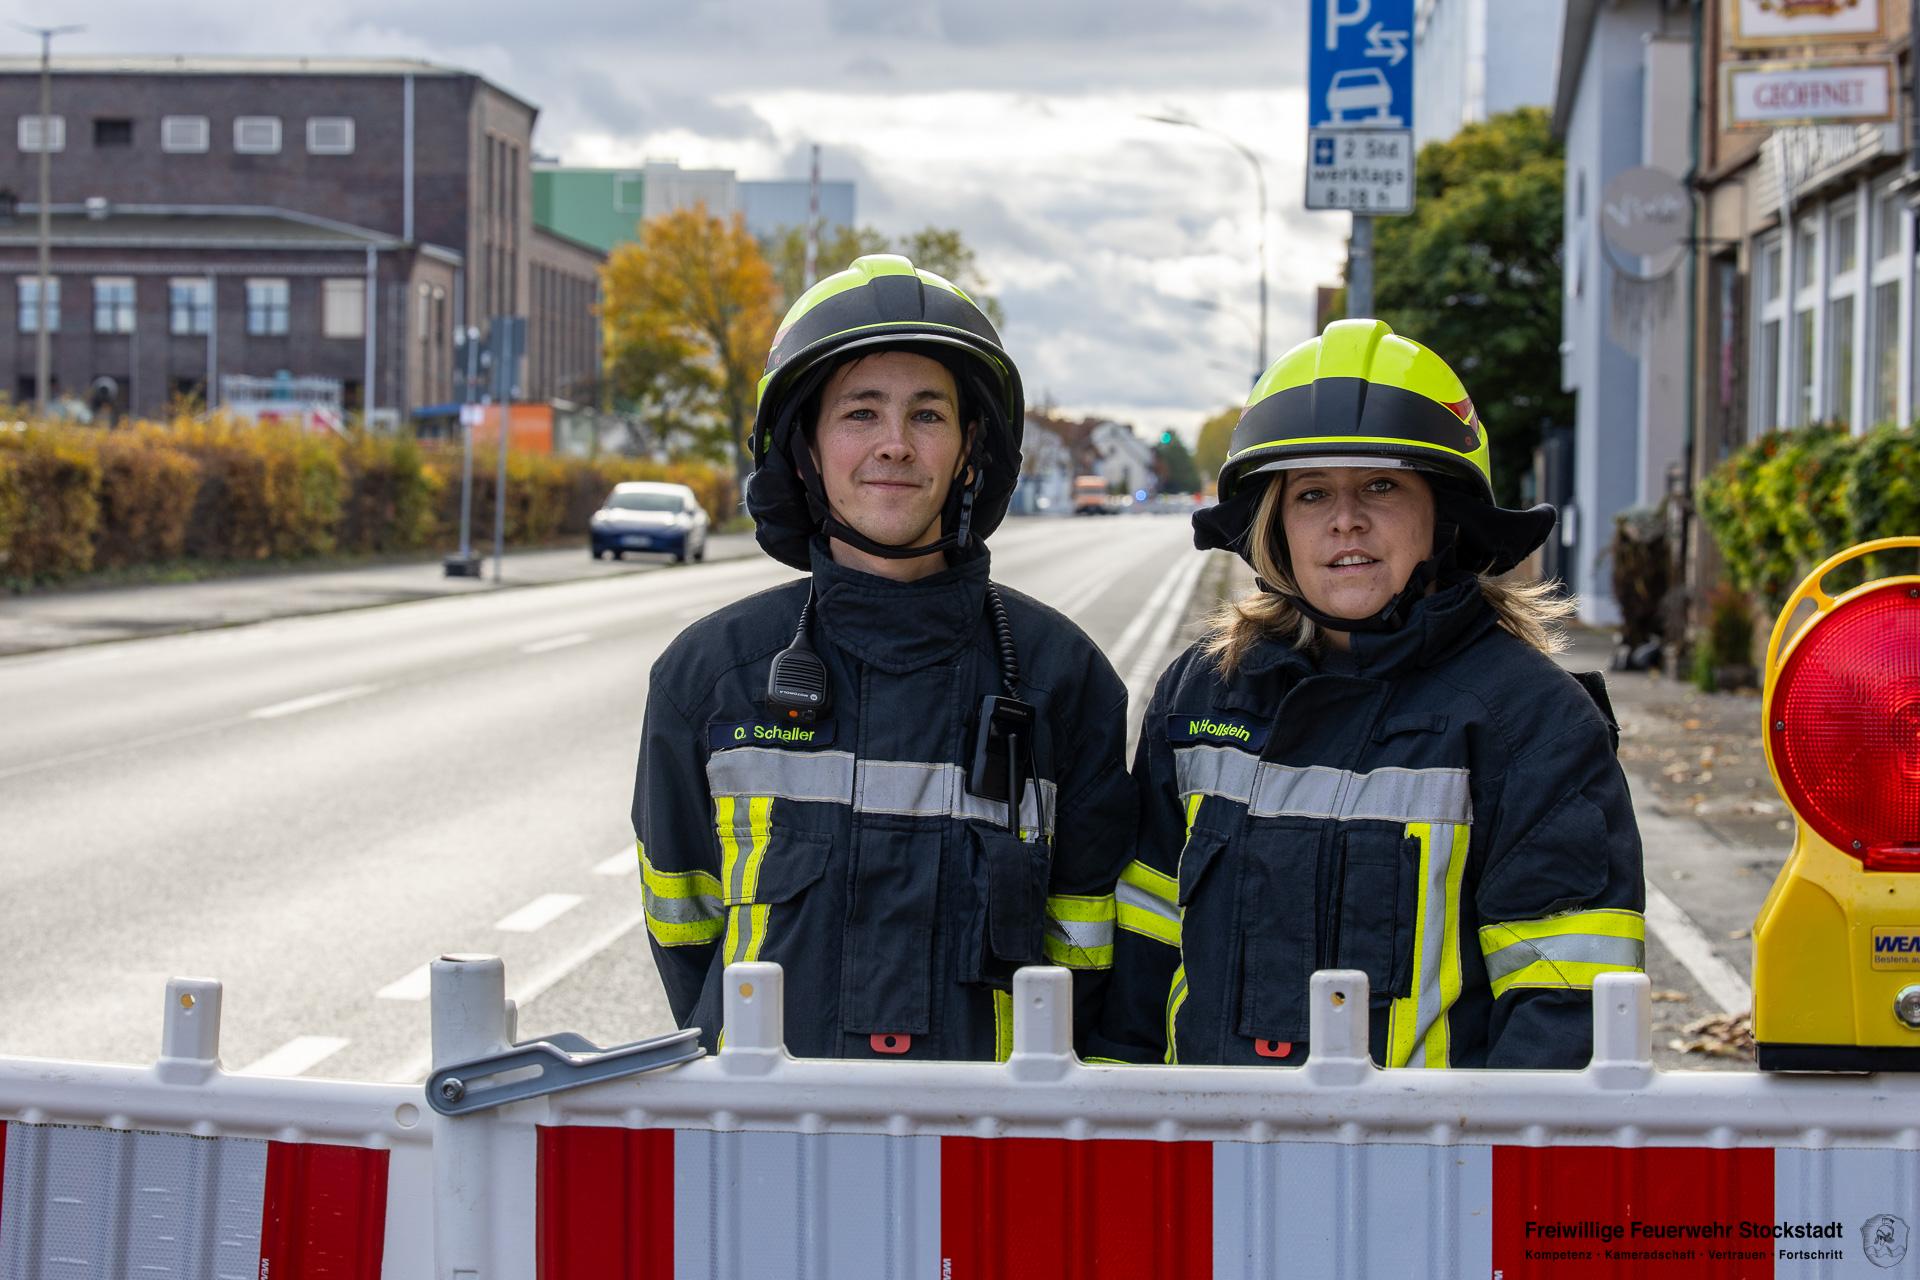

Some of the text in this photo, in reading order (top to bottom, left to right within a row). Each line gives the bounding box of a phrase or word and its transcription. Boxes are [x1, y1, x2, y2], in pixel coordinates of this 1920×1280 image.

[1325, 0, 1371, 51] P
[1344, 137, 1356, 160] 2
[1313, 163, 1404, 187] werktags
[1376, 188, 1390, 206] h
[753, 725, 815, 743] Schaller
[1875, 955, 1909, 964] Bestens
